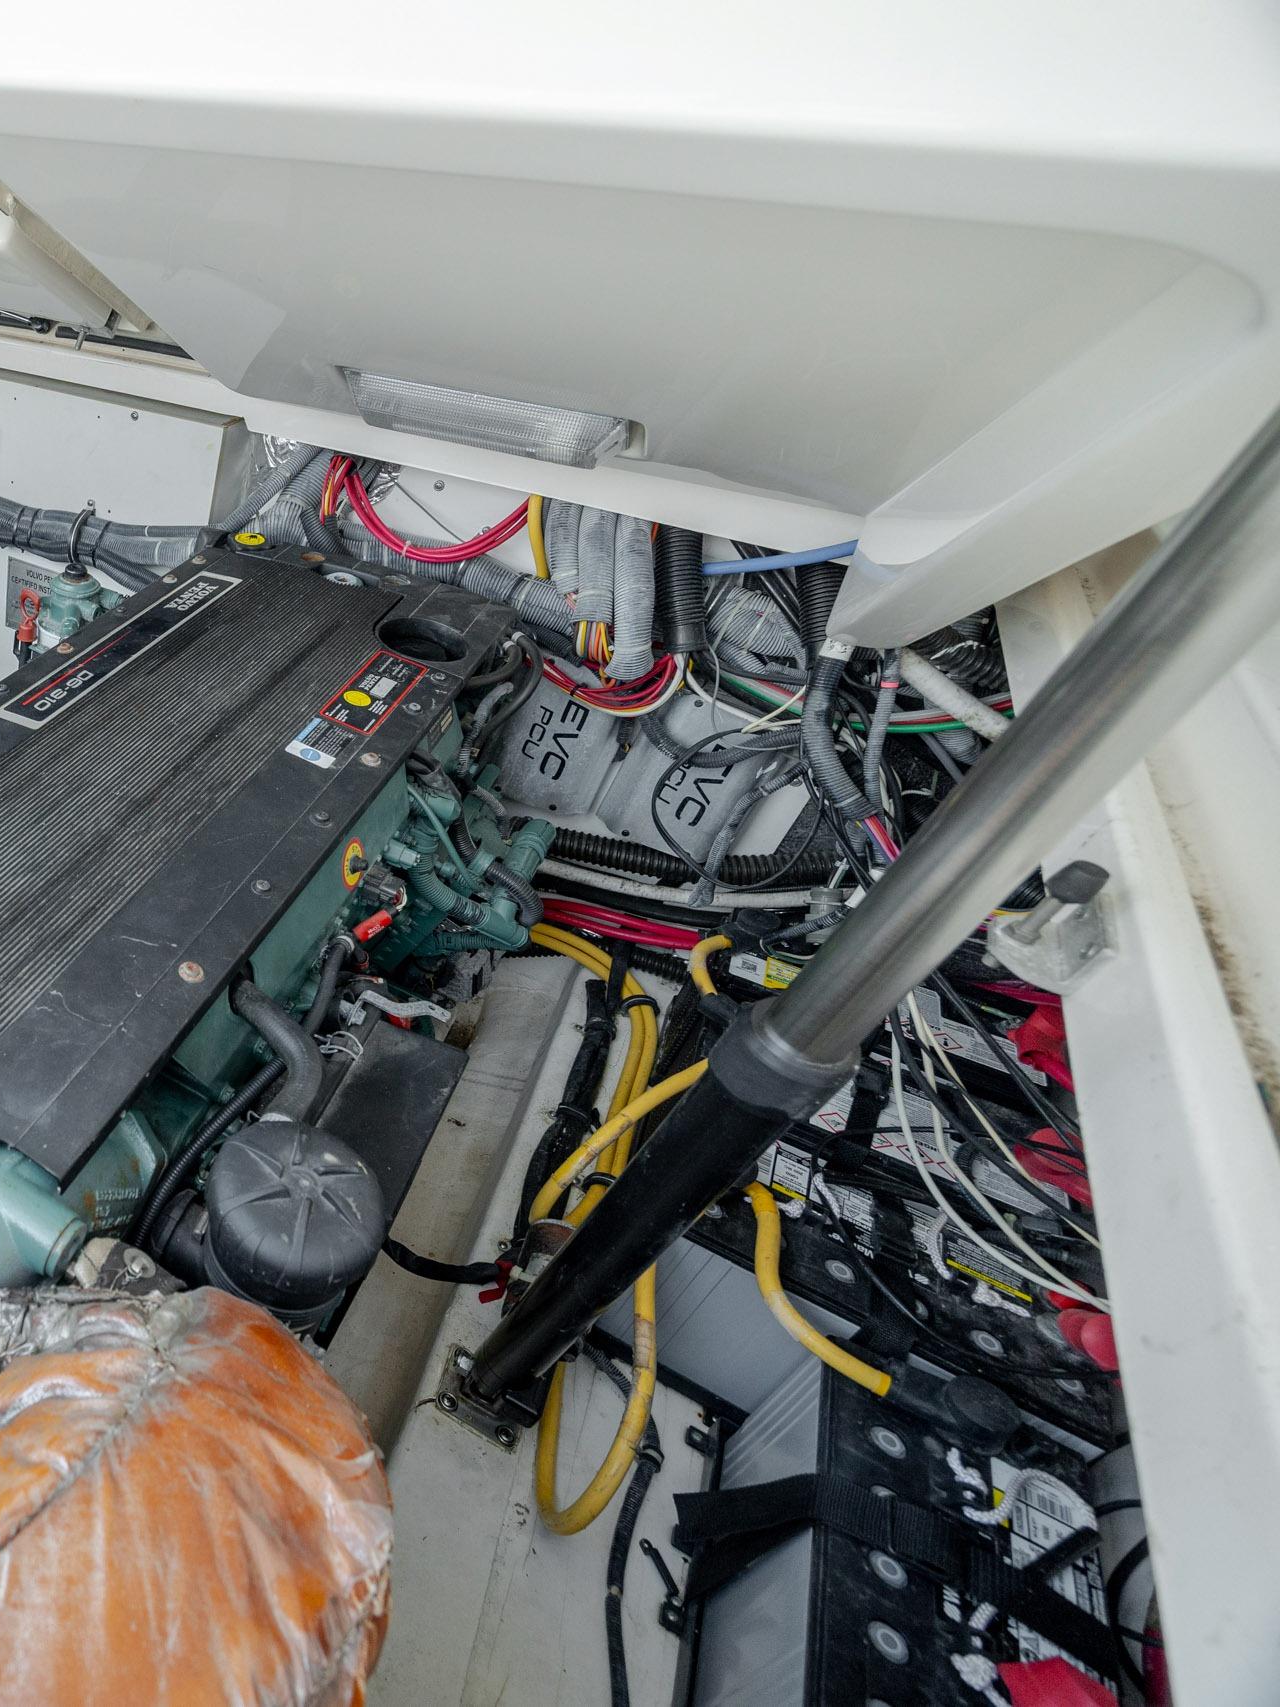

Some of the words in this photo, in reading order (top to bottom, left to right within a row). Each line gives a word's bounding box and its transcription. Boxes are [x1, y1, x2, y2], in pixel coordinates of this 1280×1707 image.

[26, 569, 42, 581] VOLVO
[163, 581, 209, 609] PENTA
[177, 585, 219, 611] VOLVO
[33, 669, 95, 712] D6-310
[521, 705, 553, 760] PCU
[539, 699, 590, 781] EVC
